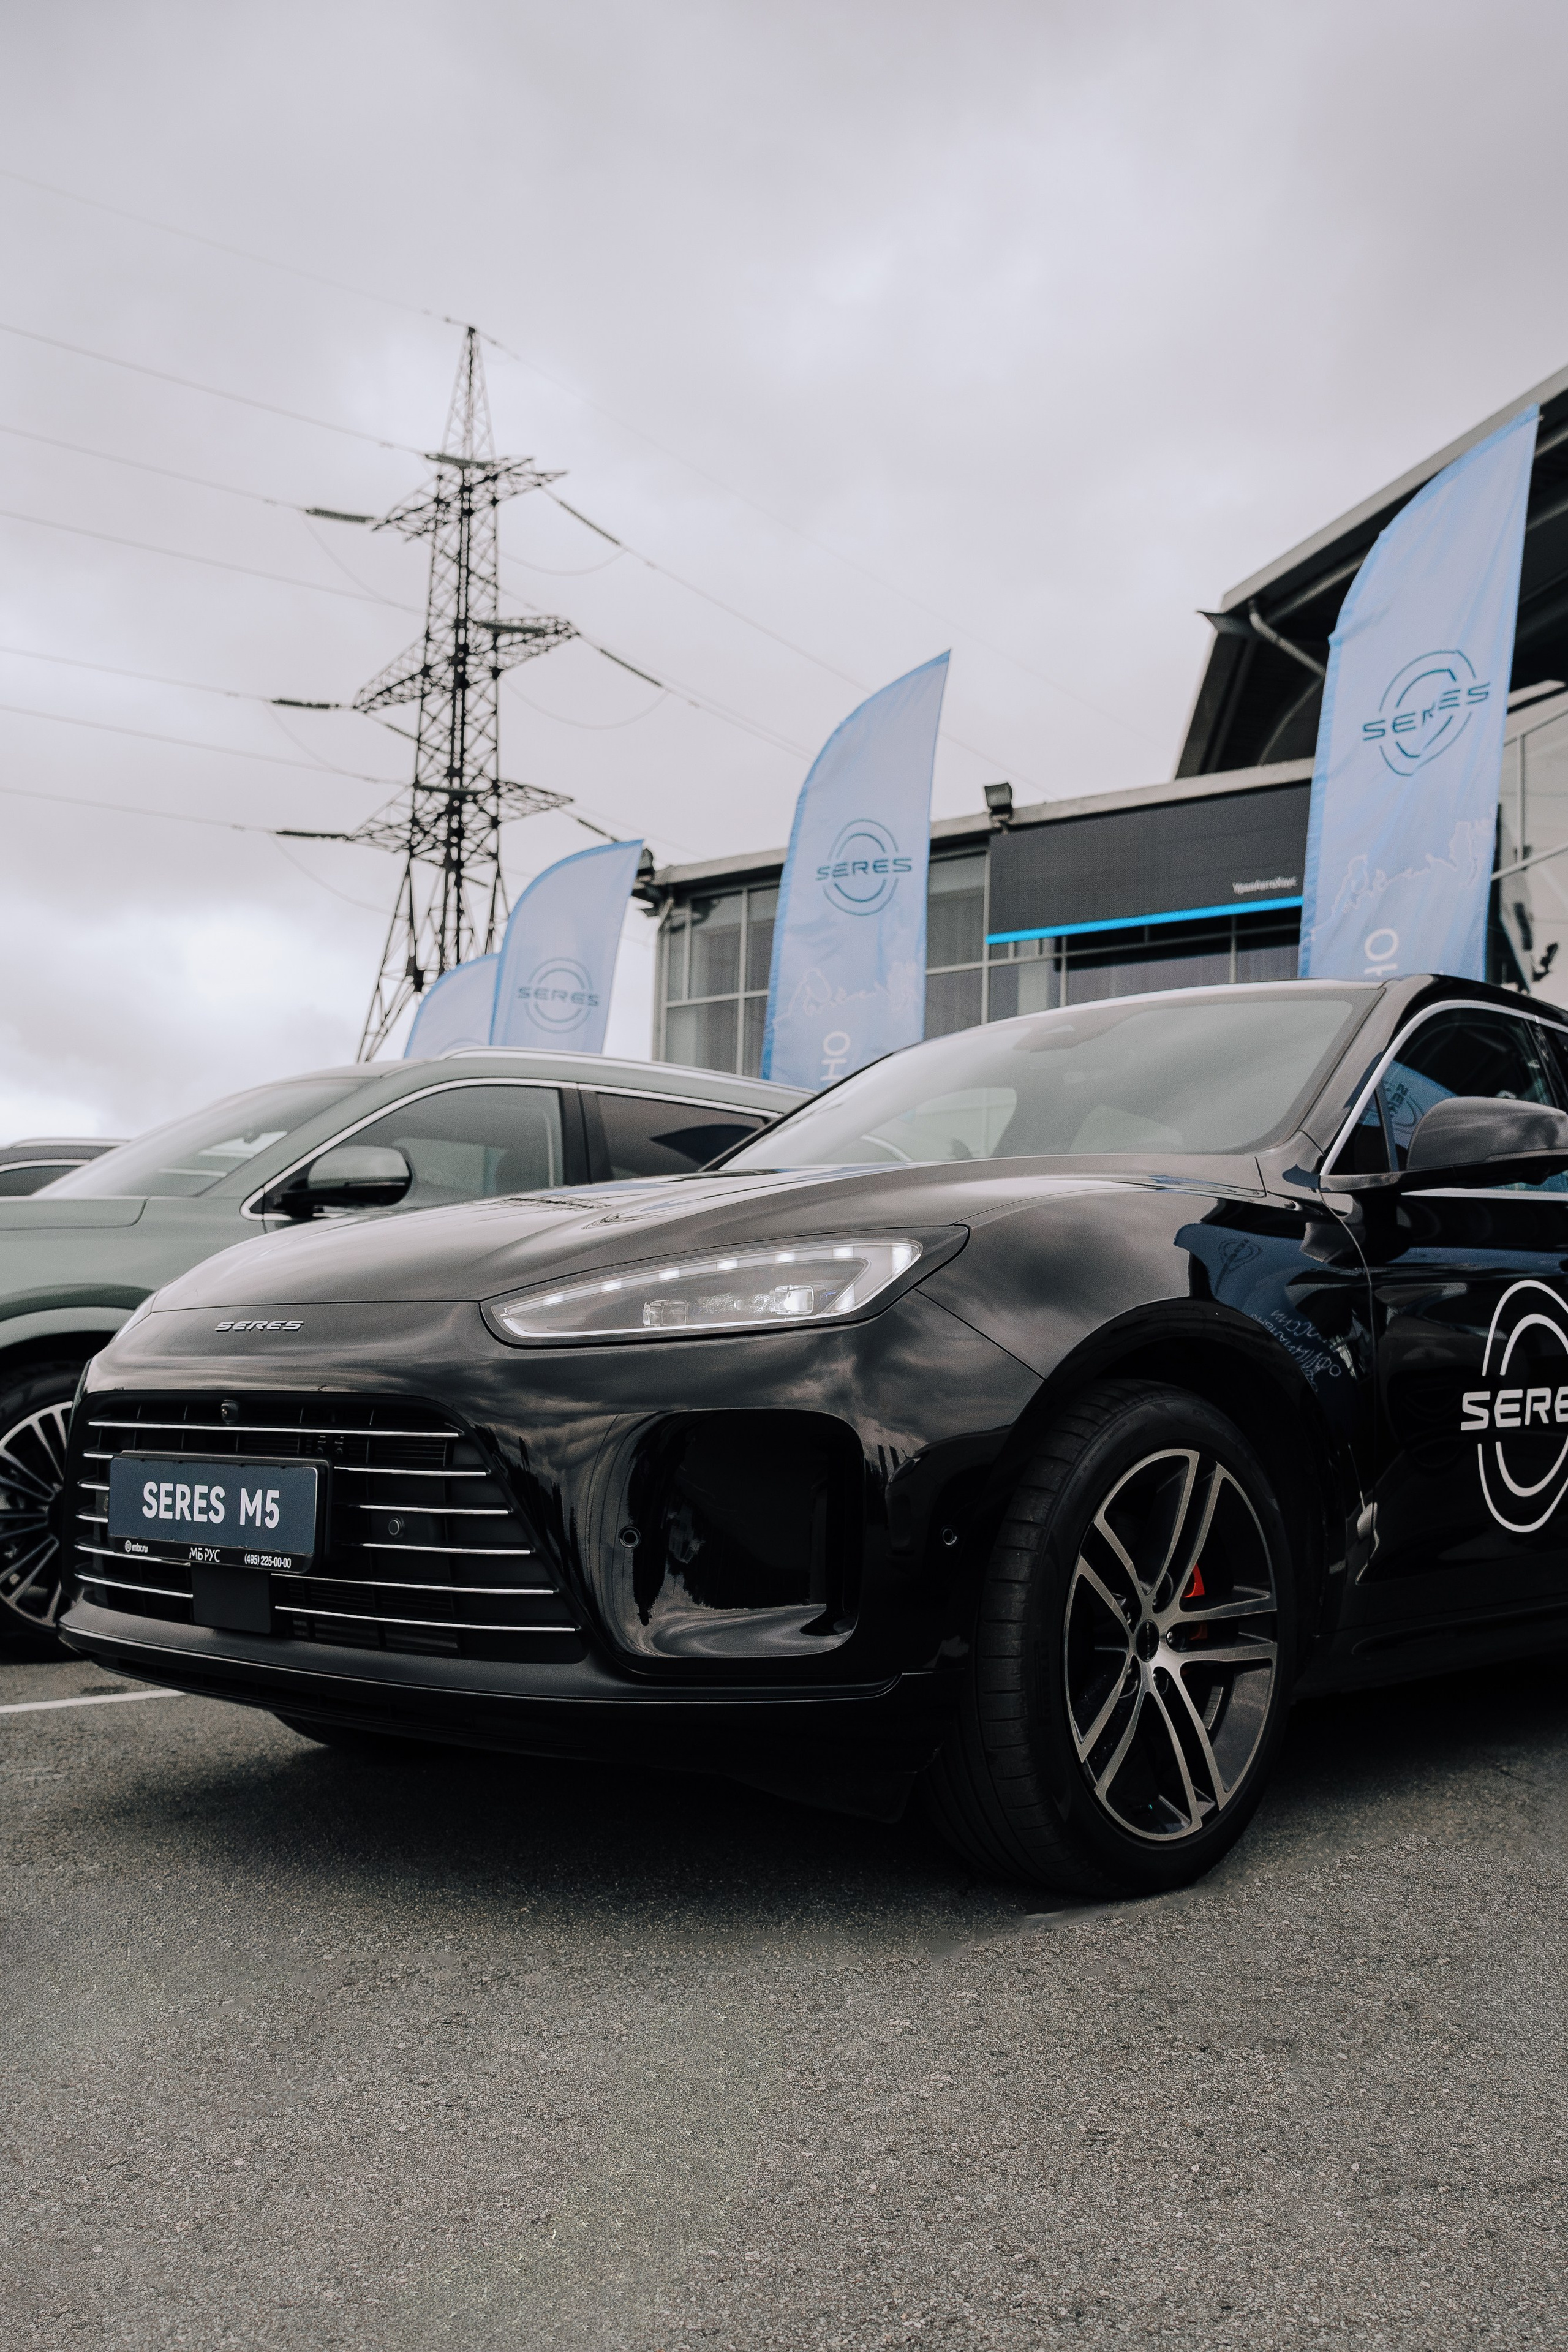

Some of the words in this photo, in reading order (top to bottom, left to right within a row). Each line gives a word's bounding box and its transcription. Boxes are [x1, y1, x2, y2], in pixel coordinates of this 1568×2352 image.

[1362, 682, 1490, 741] SERES
[815, 858, 912, 881] SERES
[517, 986, 600, 1006] SERES
[214, 1321, 304, 1331] SERES
[142, 1481, 225, 1524] SERES
[239, 1488, 280, 1529] M5
[244, 1553, 260, 1566] (495)
[260, 1555, 292, 1569] 225-00-00
